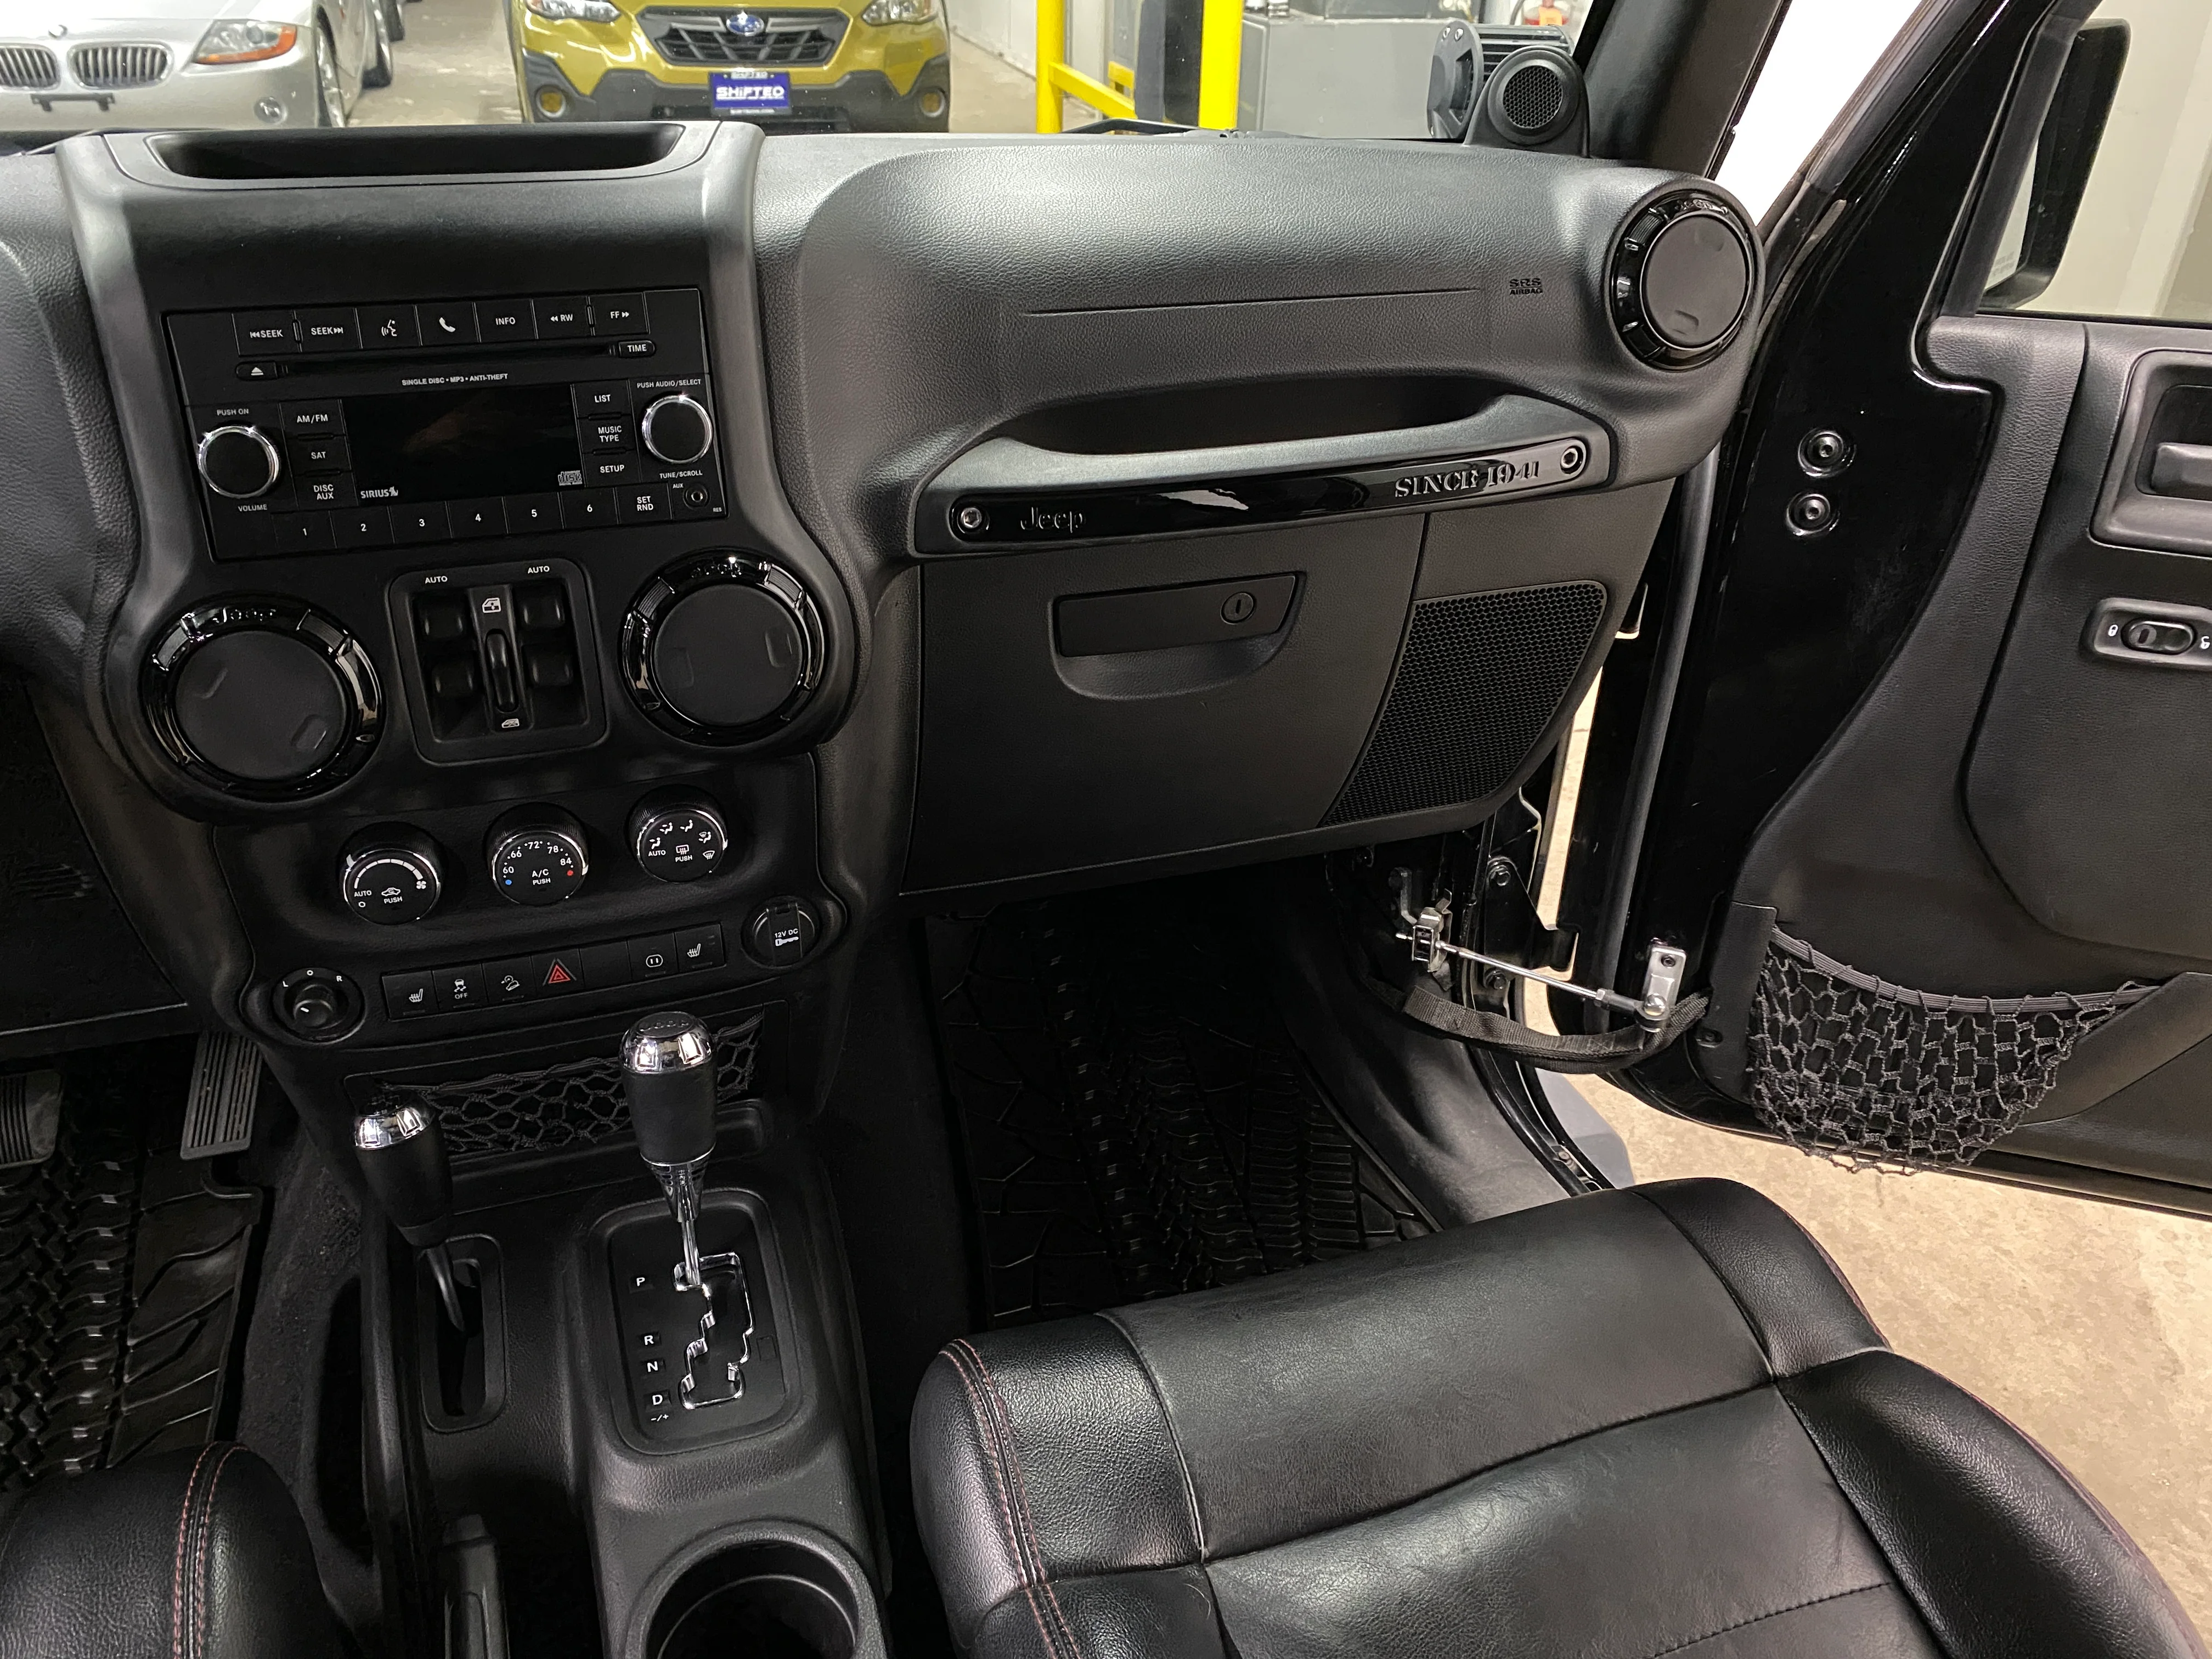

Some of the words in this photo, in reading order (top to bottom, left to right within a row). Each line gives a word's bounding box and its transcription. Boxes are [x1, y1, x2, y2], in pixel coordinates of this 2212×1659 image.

[1509, 278, 1542, 287] SRS
[560, 314, 573, 322] RW
[610, 311, 619, 319] FF
[495, 317, 516, 325] INFO
[260, 329, 284, 338] SEEK
[311, 326, 334, 336] SEEK
[627, 344, 647, 352] TIME
[402, 378, 428, 386] SINGLE
[469, 373, 508, 382] ANTI-THEFT
[655, 379, 701, 387] AUDIO/SELECT
[594, 394, 611, 403] LIST
[296, 414, 328, 424] AM/FM
[598, 426, 622, 434] MUSIC
[599, 434, 619, 443] TYPE
[311, 451, 326, 459] SAT
[600, 464, 625, 473] SETUP
[659, 470, 703, 479] TUNE/SCROLL
[1395, 470, 1479, 497] SINCE
[1486, 461, 1539, 487] 1941
[314, 484, 334, 493] DISC
[317, 492, 334, 500] AUX
[360, 489, 389, 498] SIRIUS
[238, 504, 268, 512] VOLUME
[586, 504, 593, 512] 6
[636, 503, 654, 511] RND
[531, 509, 538, 517] 5
[419, 518, 425, 527] 3
[475, 514, 482, 522] 4
[1020, 506, 1087, 533] Jeep
[302, 528, 307, 536] 1
[360, 523, 367, 532] 2
[527, 566, 550, 574] AUTO
[425, 575, 448, 584] AUTO
[527, 840, 540, 850] 72
[547, 845, 559, 854] 78
[510, 850, 522, 859] 66
[675, 854, 693, 862] PUSH
[503, 866, 515, 874] 60
[532, 868, 549, 878] A/C
[532, 877, 551, 885] PUSH
[383, 895, 403, 904] PUSH
[774, 930, 787, 938] 12V
[636, 1277, 645, 1286] P
[644, 1335, 654, 1346] R
[647, 1361, 658, 1373] N
[652, 1394, 663, 1406] D
